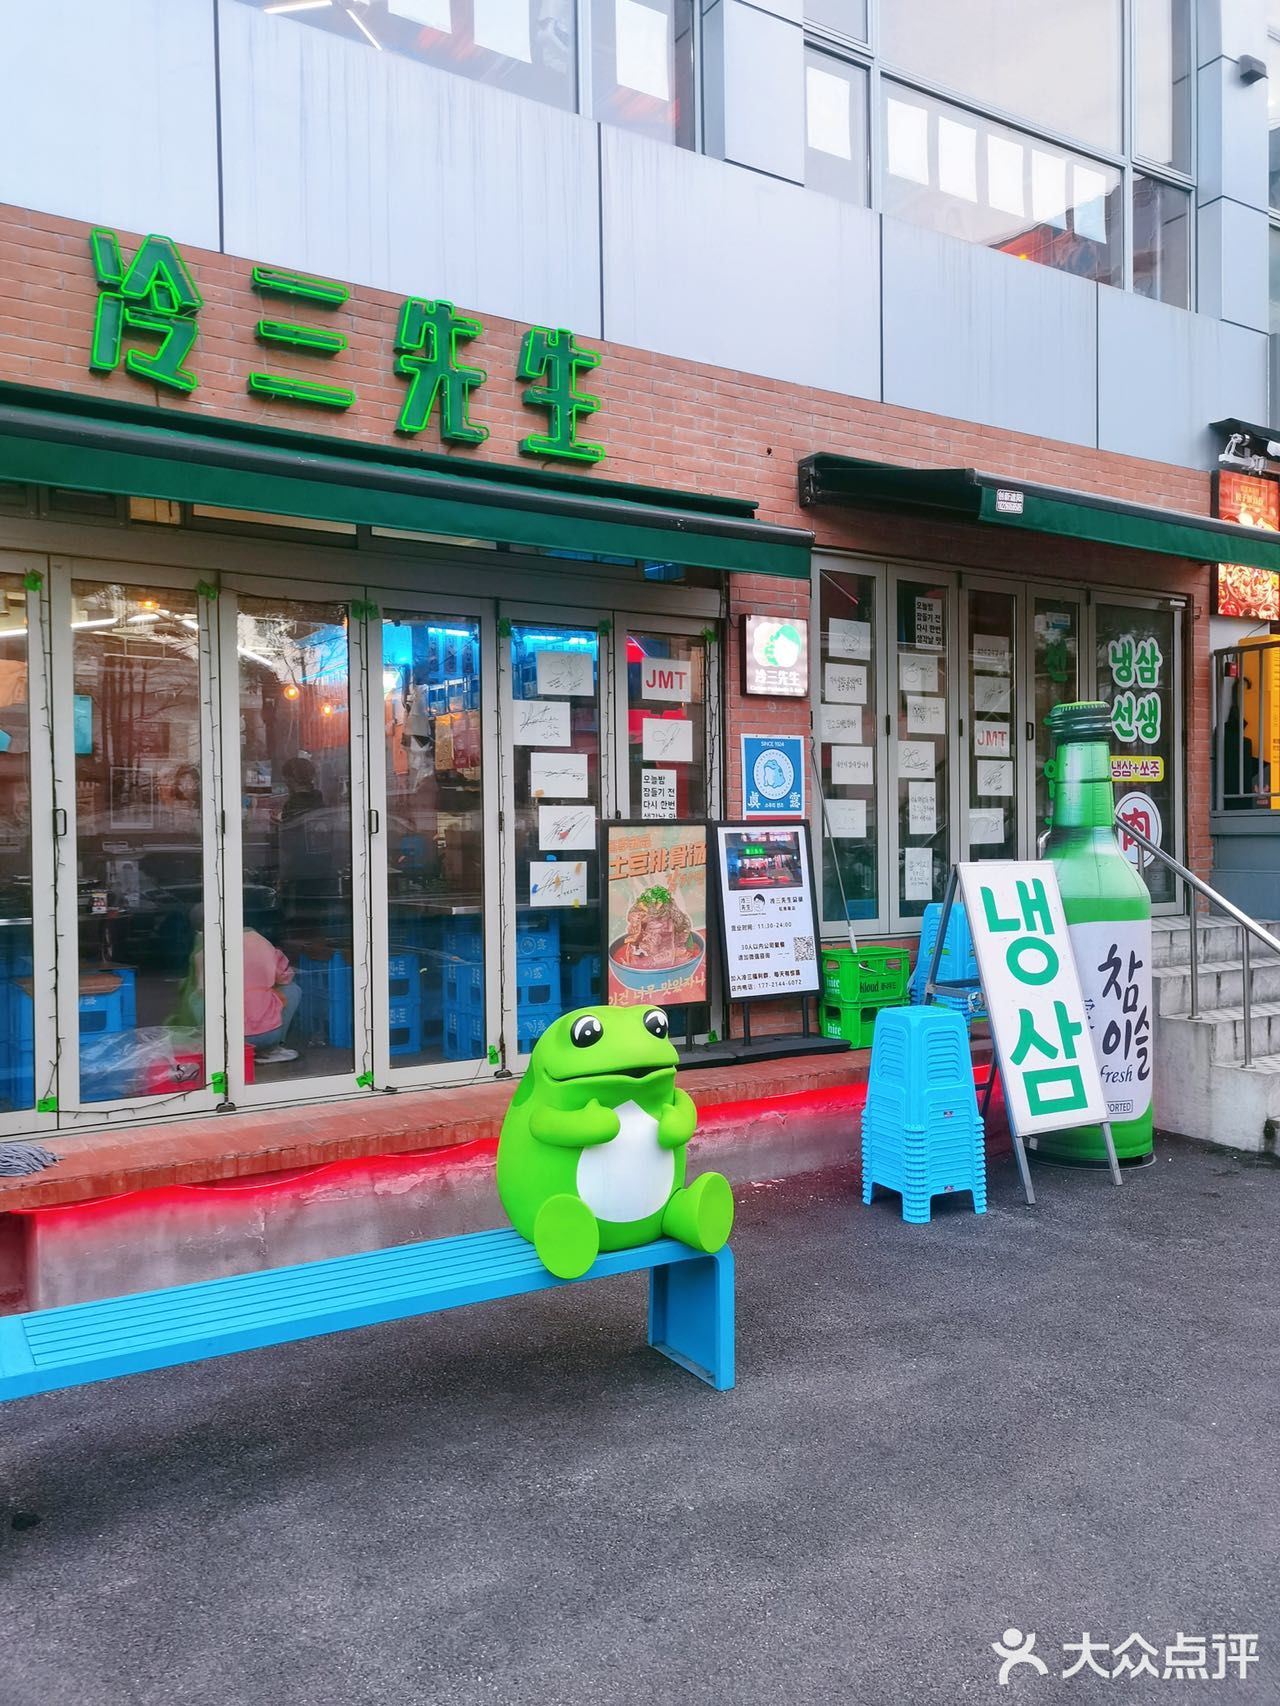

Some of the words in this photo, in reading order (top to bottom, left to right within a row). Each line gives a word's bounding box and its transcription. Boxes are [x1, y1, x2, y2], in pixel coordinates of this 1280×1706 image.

[90, 228, 606, 463] 冷三先生
[917, 624, 927, 632] 다시
[1110, 637, 1161, 686] 냉삼
[646, 669, 687, 689] JMT
[755, 669, 800, 686] 冷三先生
[1112, 694, 1161, 740] 선생
[978, 731, 1007, 747] JMT
[1111, 759, 1160, 778] 냉삼+쏘주
[643, 775, 665, 785] 오늘밤
[643, 788, 665, 798] 잠들기
[668, 788, 675, 798] 전
[643, 800, 658, 810] 다시
[661, 800, 675, 810] 한번
[1122, 808, 1150, 851] 肉
[608, 842, 707, 881] 土豆排骨汤
[634, 983, 655, 1002] 너무
[980, 878, 1089, 1117] 냉삼
